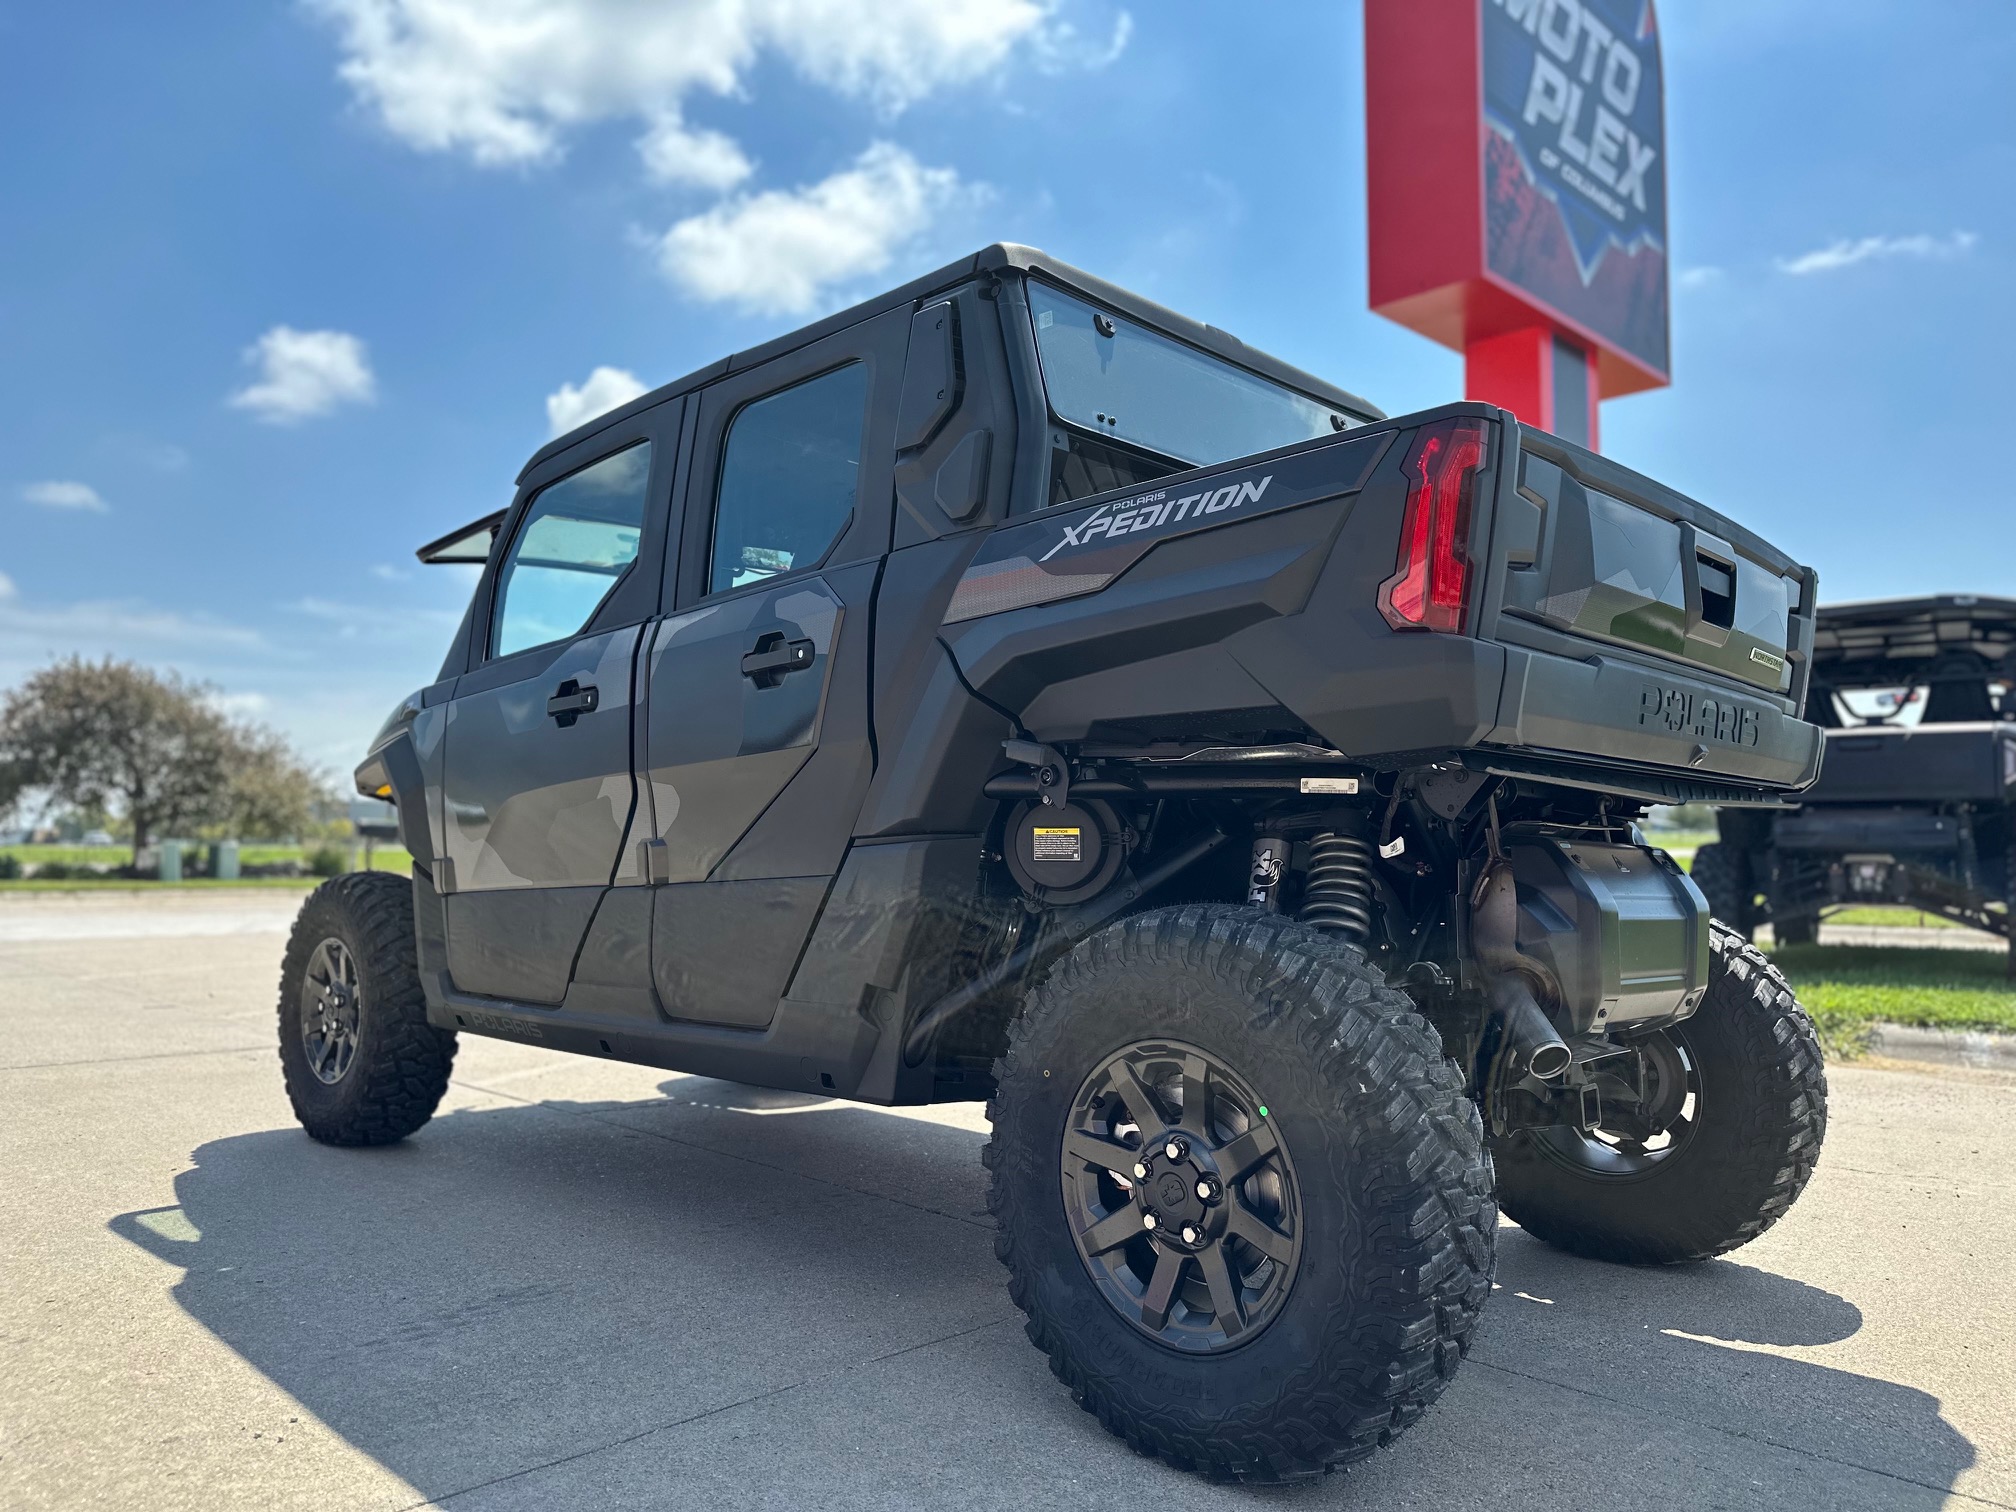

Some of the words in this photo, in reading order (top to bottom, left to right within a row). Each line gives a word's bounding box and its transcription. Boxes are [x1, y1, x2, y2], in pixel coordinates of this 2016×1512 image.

[1523, 51, 1656, 213] PLEX
[1039, 475, 1273, 562] XPEDITION
[1112, 491, 1166, 512] POLARIS
[1638, 684, 1760, 747] POLARIS
[1249, 849, 1284, 902] FOX
[473, 1014, 543, 1038] POLARIS
